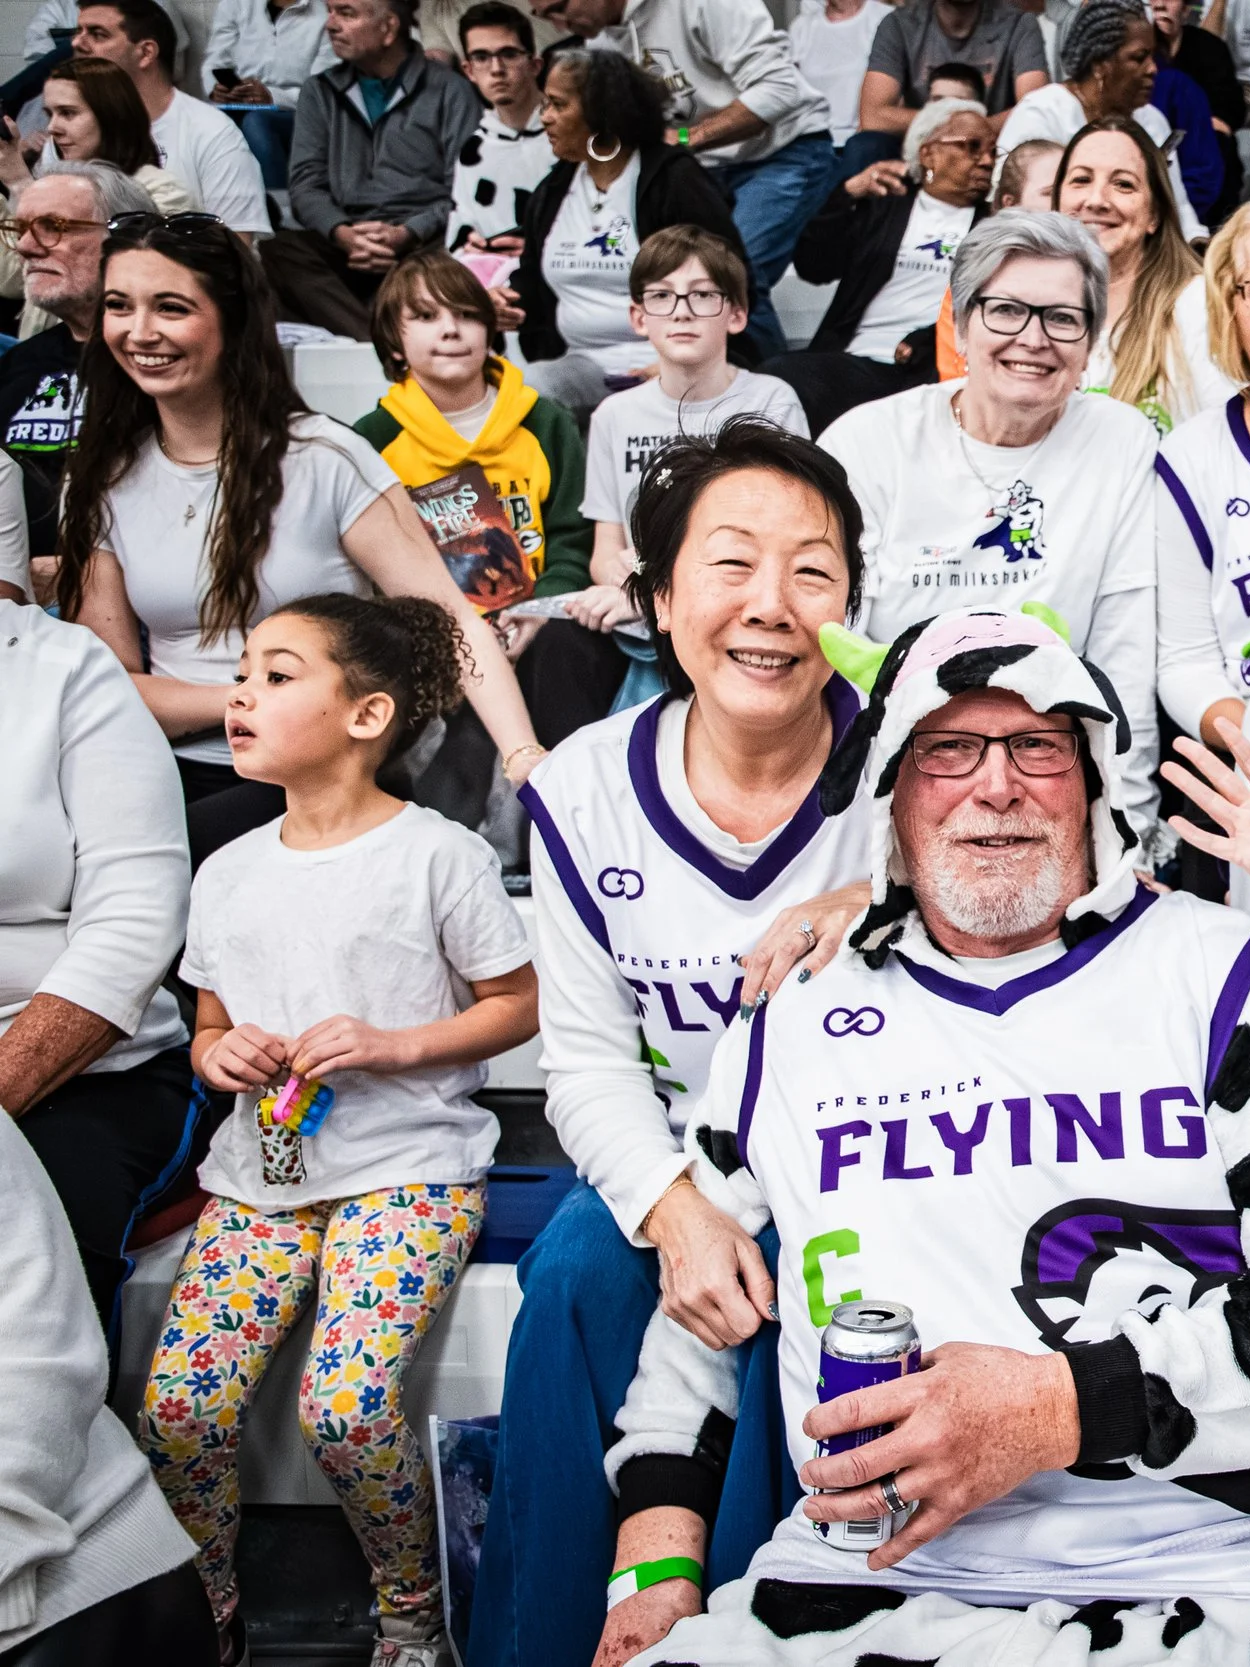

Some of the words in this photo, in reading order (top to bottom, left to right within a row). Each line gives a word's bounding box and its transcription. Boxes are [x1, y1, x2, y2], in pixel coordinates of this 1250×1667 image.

[413, 483, 479, 523] WINGS
[912, 572, 941, 588] got
[816, 1075, 983, 1113] FREDERICK
[815, 1086, 1208, 1194] FLYING
